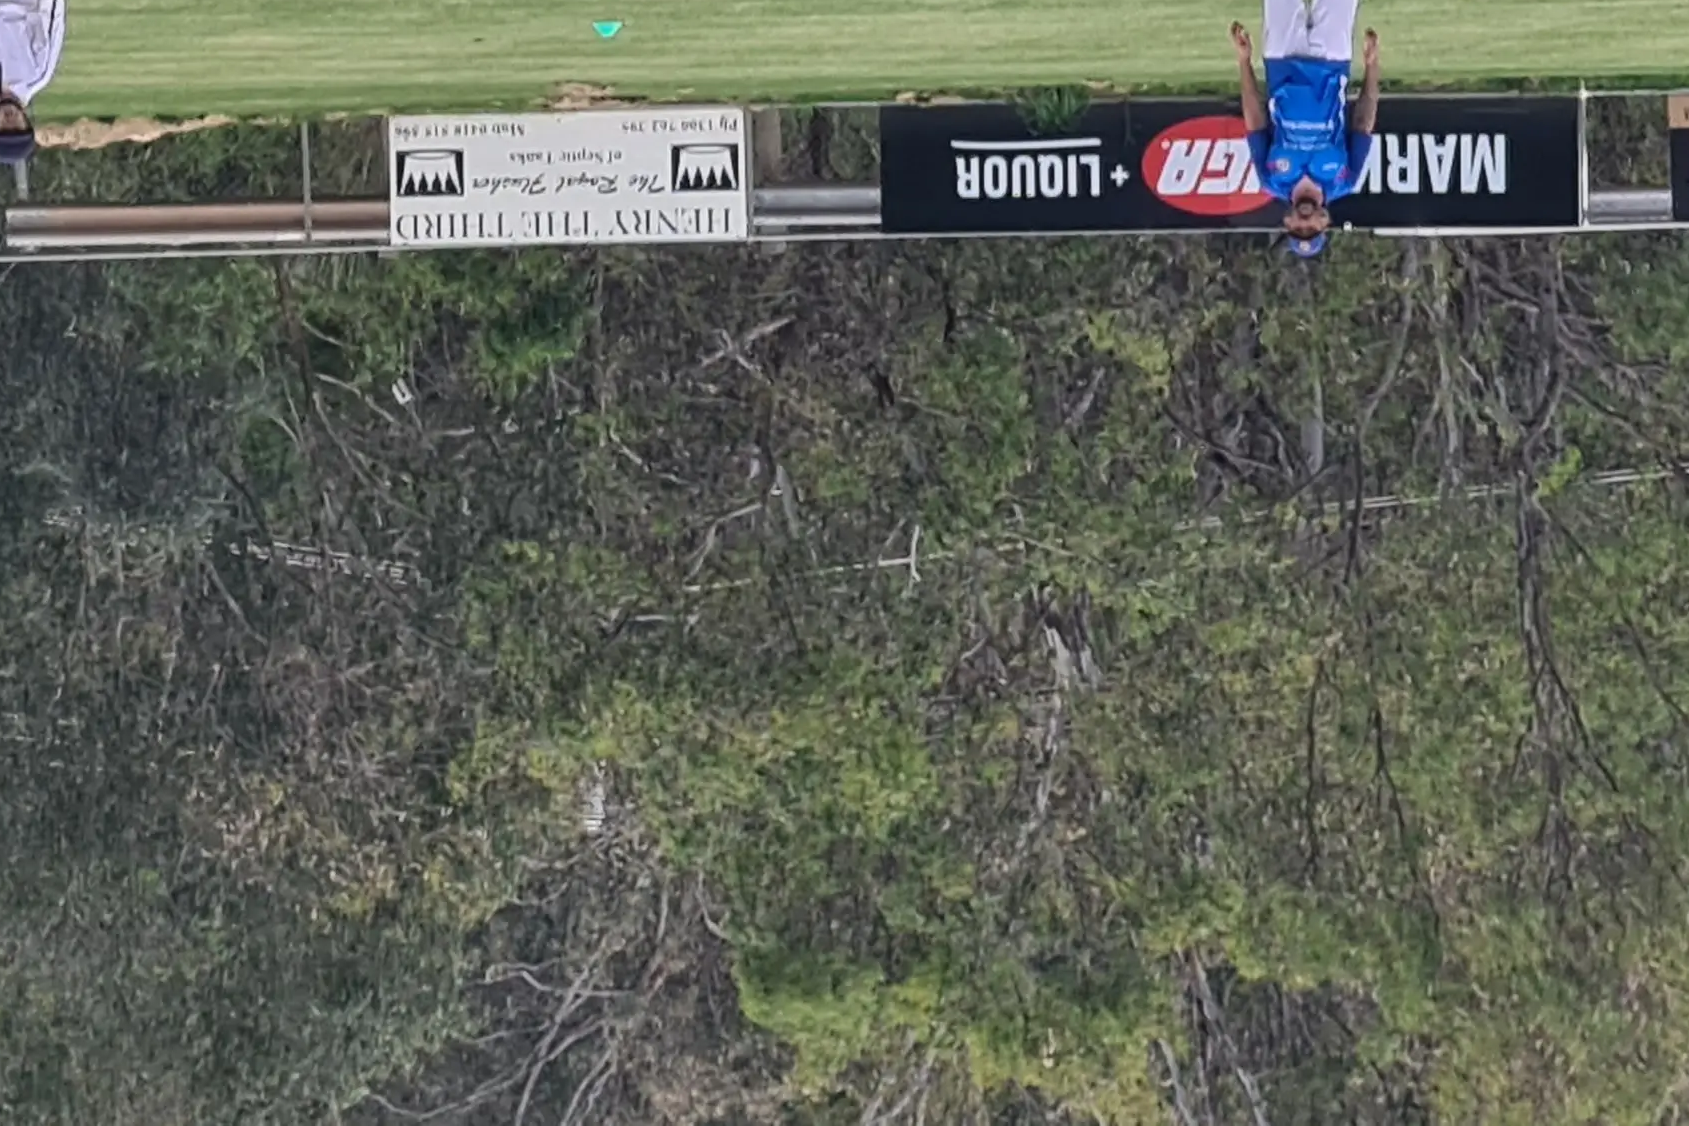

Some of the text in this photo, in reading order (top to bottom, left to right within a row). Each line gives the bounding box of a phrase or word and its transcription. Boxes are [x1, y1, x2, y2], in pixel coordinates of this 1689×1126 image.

[509, 148, 622, 165] of Septic Tanks
[1156, 138, 1260, 195] IGA
[470, 172, 665, 196] The Royal Flusher
[955, 152, 1102, 199] LIQUOR
[396, 207, 732, 241] HENRY THE THIRD
